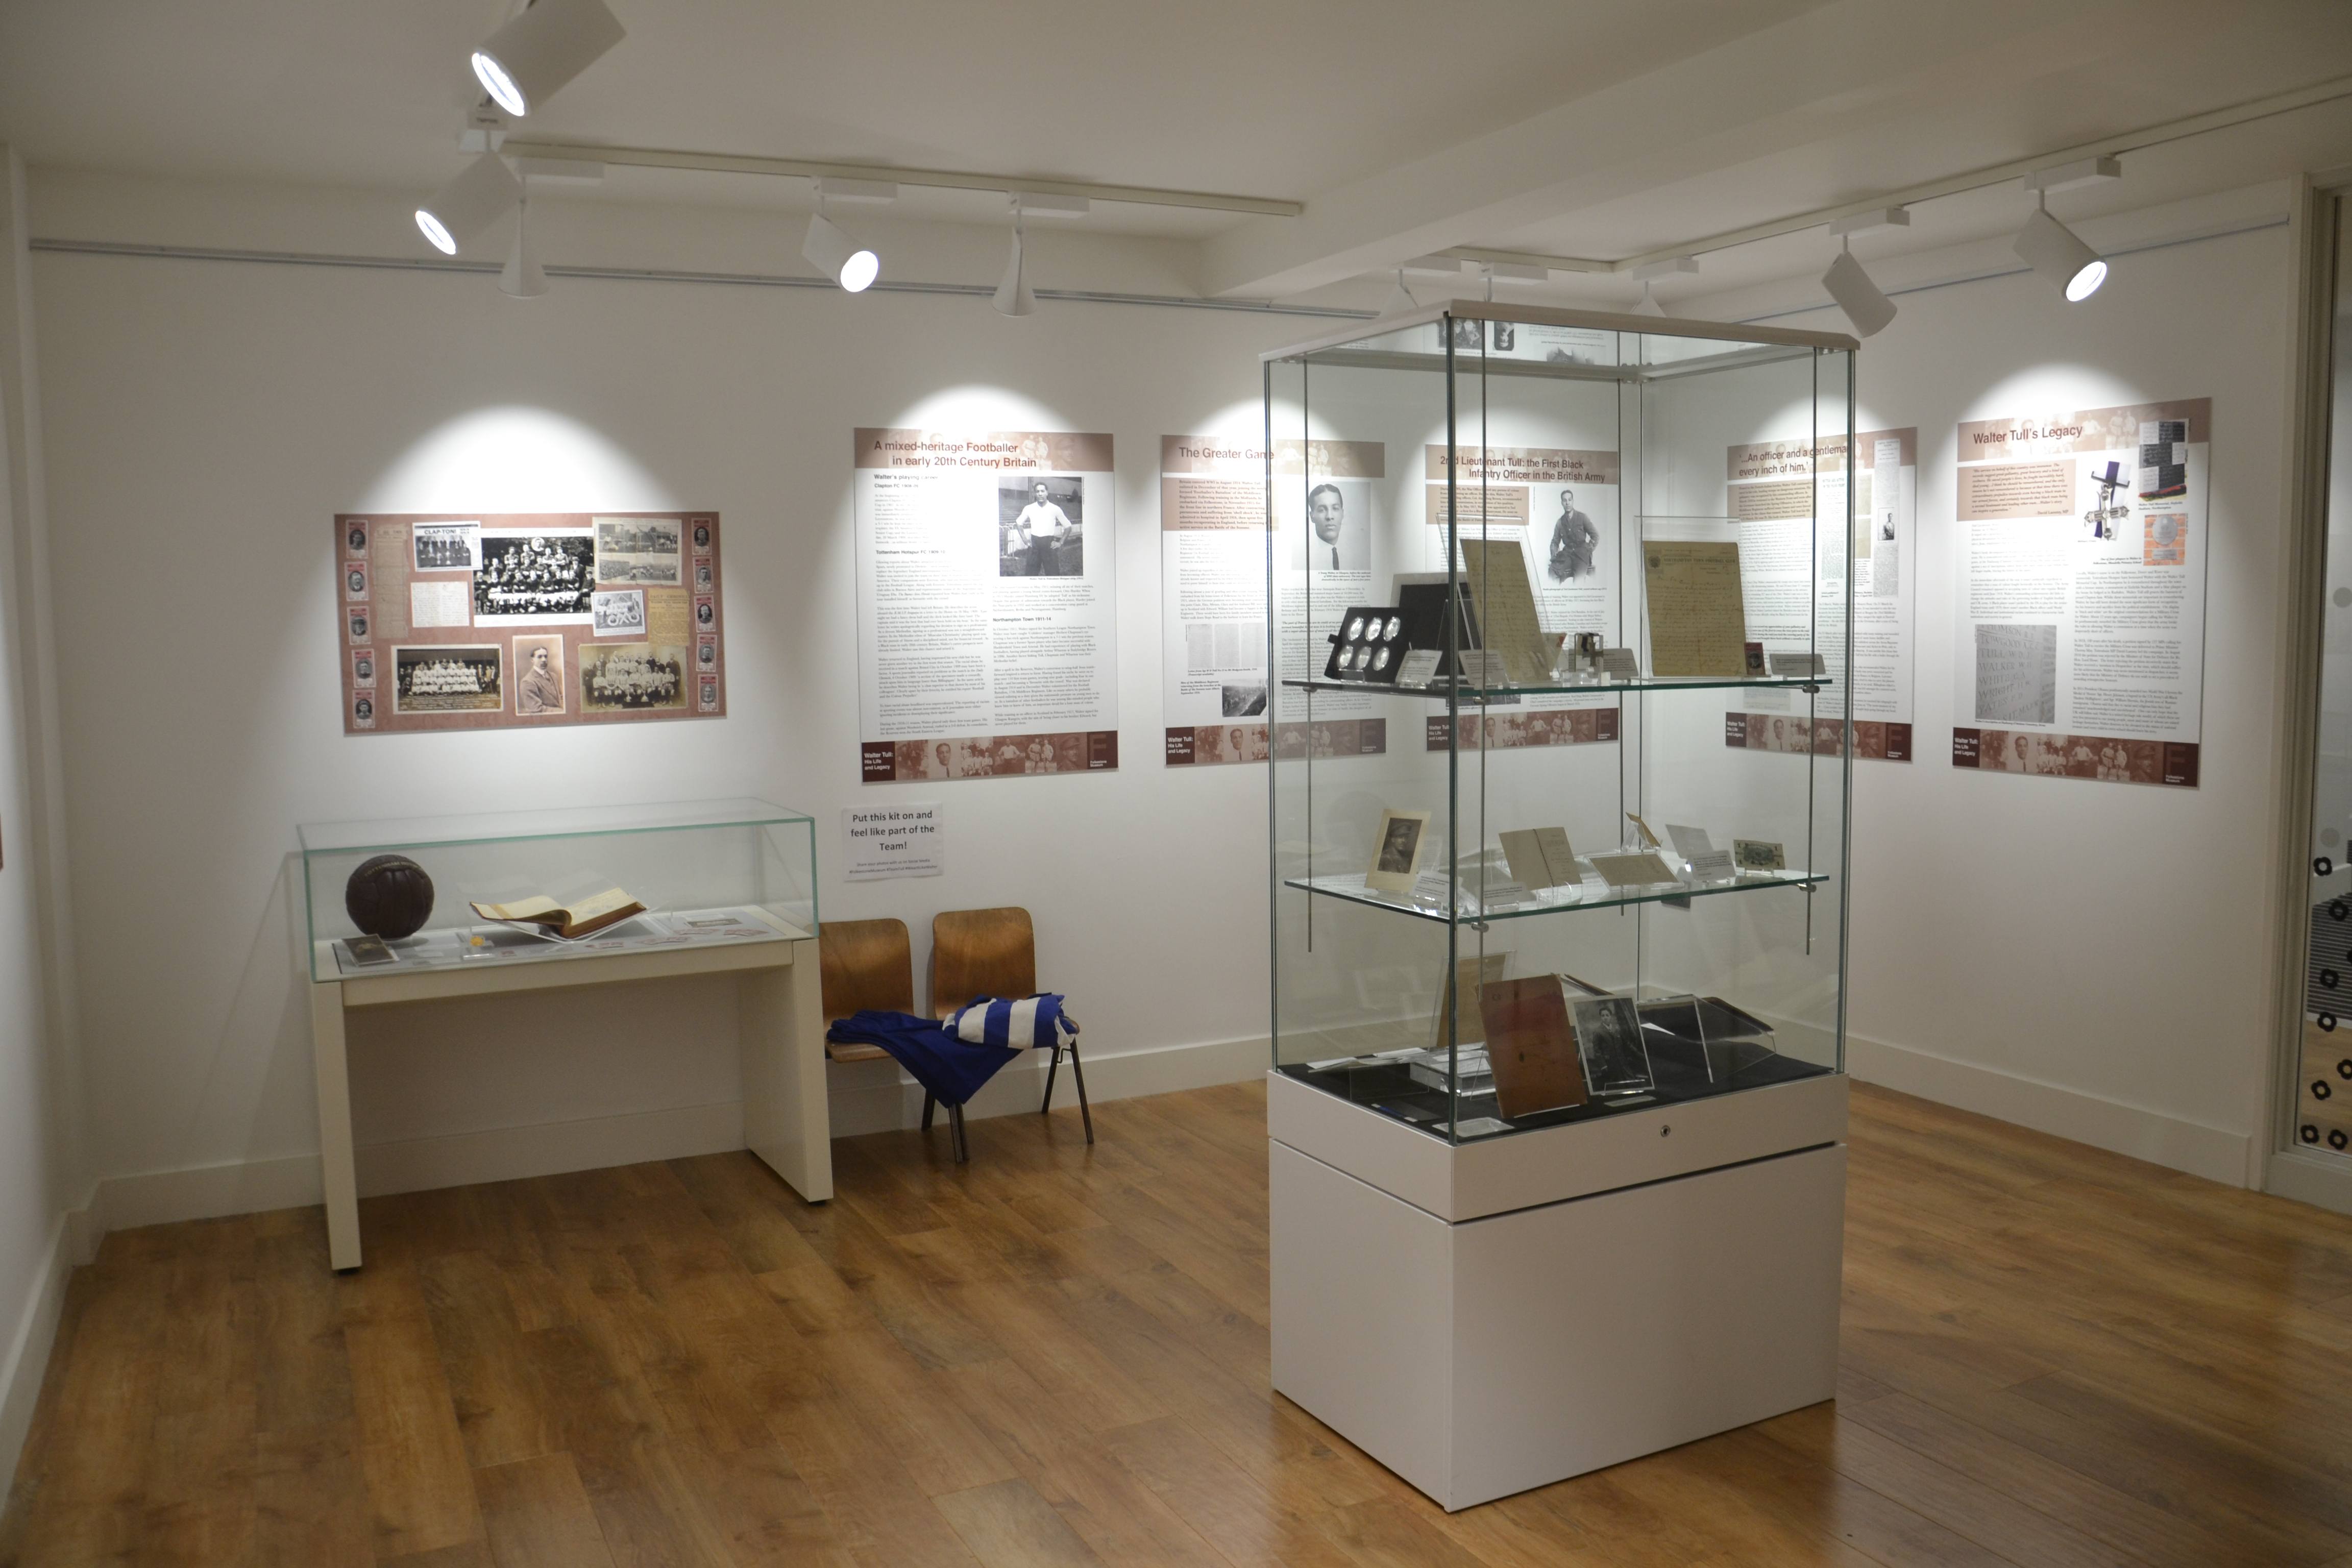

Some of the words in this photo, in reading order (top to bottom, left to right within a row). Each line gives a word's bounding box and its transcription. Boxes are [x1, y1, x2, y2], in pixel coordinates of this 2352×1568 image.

[1973, 432, 2006, 444] Walter
[2010, 429, 2038, 440] Tull's
[2043, 426, 2082, 439] Legacy
[874, 441, 882, 450] A
[885, 441, 963, 453] mixed-heritage
[967, 442, 1018, 453] Footballer
[1179, 447, 1199, 457] The
[1203, 448, 1242, 458] Greater
[1760, 452, 1783, 460] officer
[1786, 449, 1801, 458] and
[1810, 446, 1847, 458] gentlema
[893, 456, 902, 465] in
[905, 457, 930, 468] early
[934, 457, 956, 465] 20th
[960, 457, 1000, 469] Century
[1003, 457, 1037, 468] Britain
[1461, 456, 1505, 467] Lieutnant
[1507, 458, 1525, 467] Tull:
[1527, 459, 1539, 468] the
[1542, 459, 1560, 468] First
[1562, 460, 1584, 469] Black
[1469, 469, 1501, 480] Infantry
[1503, 470, 1531, 479] Officer
[1533, 471, 1540, 479] in
[1542, 471, 1555, 480] the
[1557, 472, 1583, 480] British
[1585, 473, 1605, 483] Army
[1739, 468, 1759, 477] every
[1762, 465, 1777, 474] inch
[1780, 463, 1787, 473] of
[853, 814, 867, 822] Put
[870, 813, 886, 821] this
[889, 812, 899, 820] kit
[916, 811, 933, 819] and
[851, 828, 868, 837] feel
[888, 827, 906, 837] part
[909, 825, 918, 834] of
[879, 842, 907, 850] Team!
